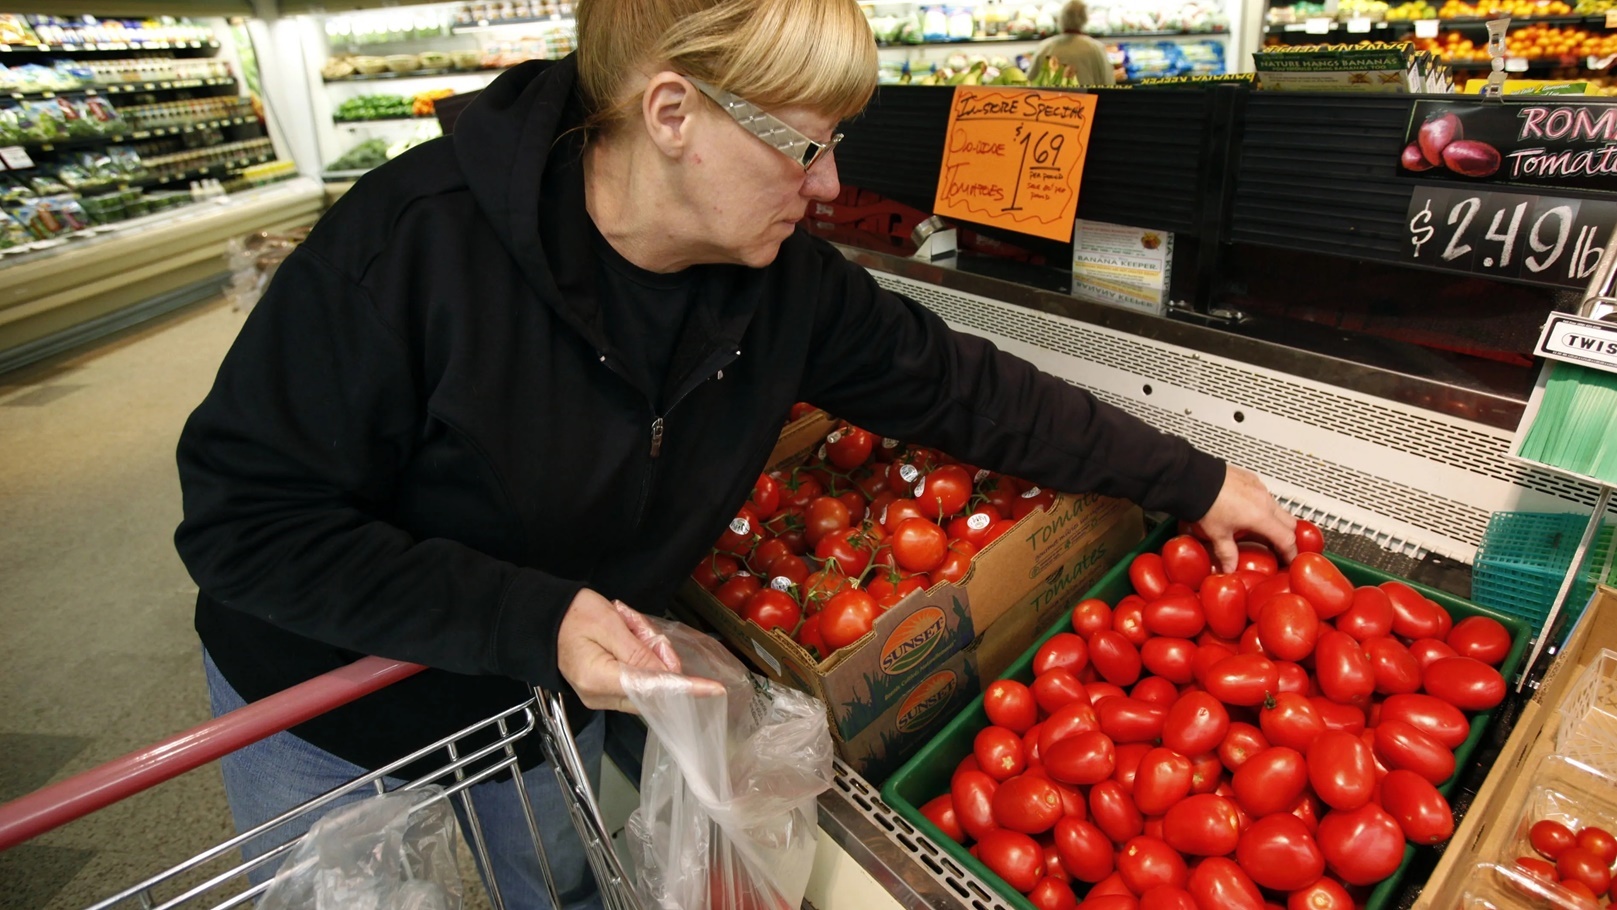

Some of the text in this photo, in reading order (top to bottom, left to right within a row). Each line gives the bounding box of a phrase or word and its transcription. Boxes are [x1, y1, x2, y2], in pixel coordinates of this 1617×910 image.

[1342, 58, 1398, 67] BANANAS
[1517, 107, 1617, 142] ROM
[1506, 144, 1617, 177] Tomat
[1077, 254, 1118, 266] BANANA
[1568, 225, 1604, 279] lb
[882, 616, 944, 671] SUNSET
[899, 678, 955, 729] SUNSET
